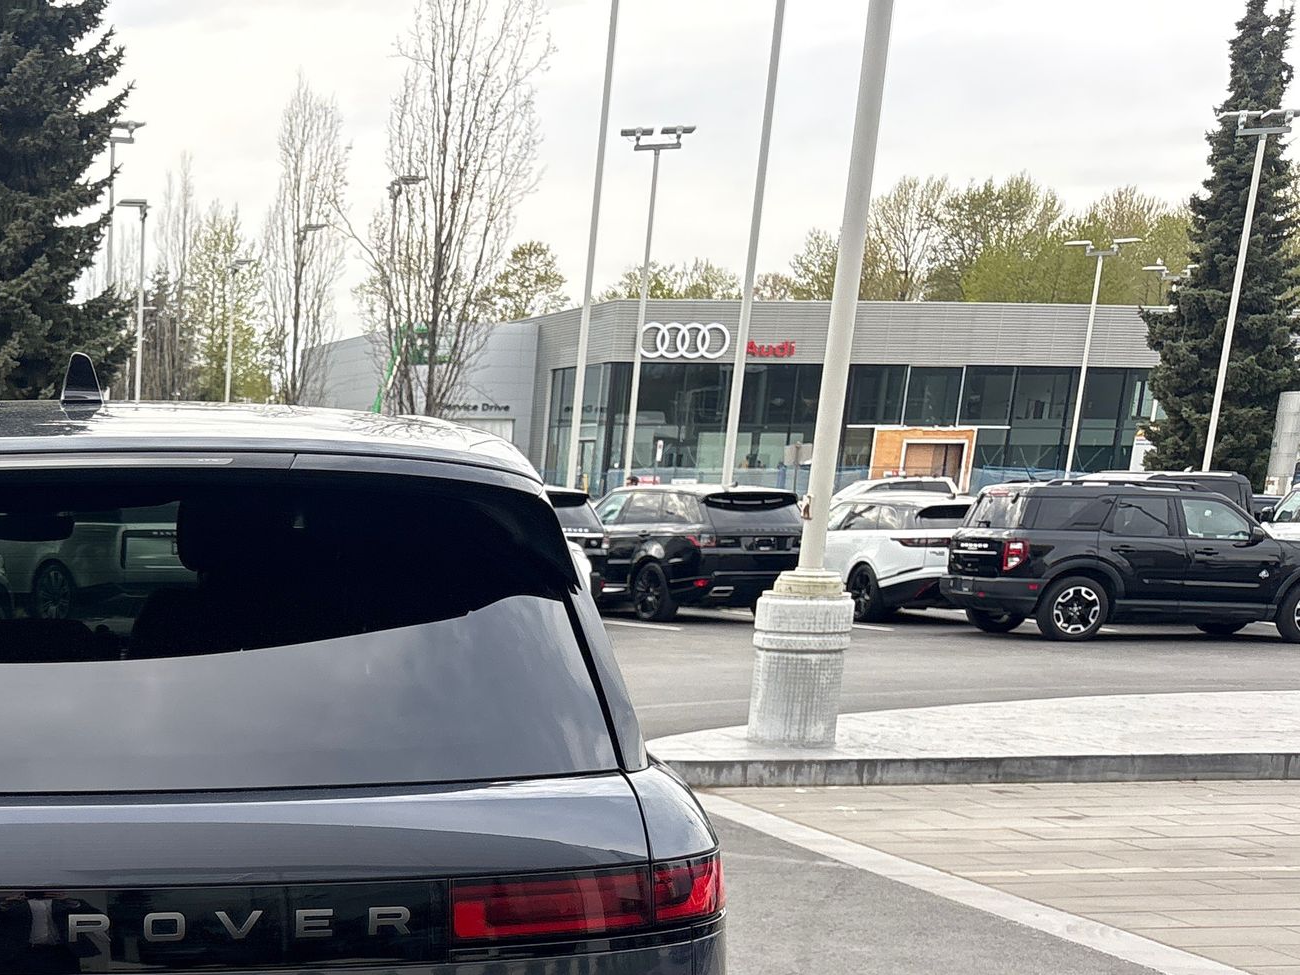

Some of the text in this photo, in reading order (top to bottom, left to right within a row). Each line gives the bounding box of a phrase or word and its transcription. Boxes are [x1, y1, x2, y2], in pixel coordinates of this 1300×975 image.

[747, 339, 796, 357] Audi
[481, 403, 510, 413] Drive
[67, 905, 411, 944] ROVER
